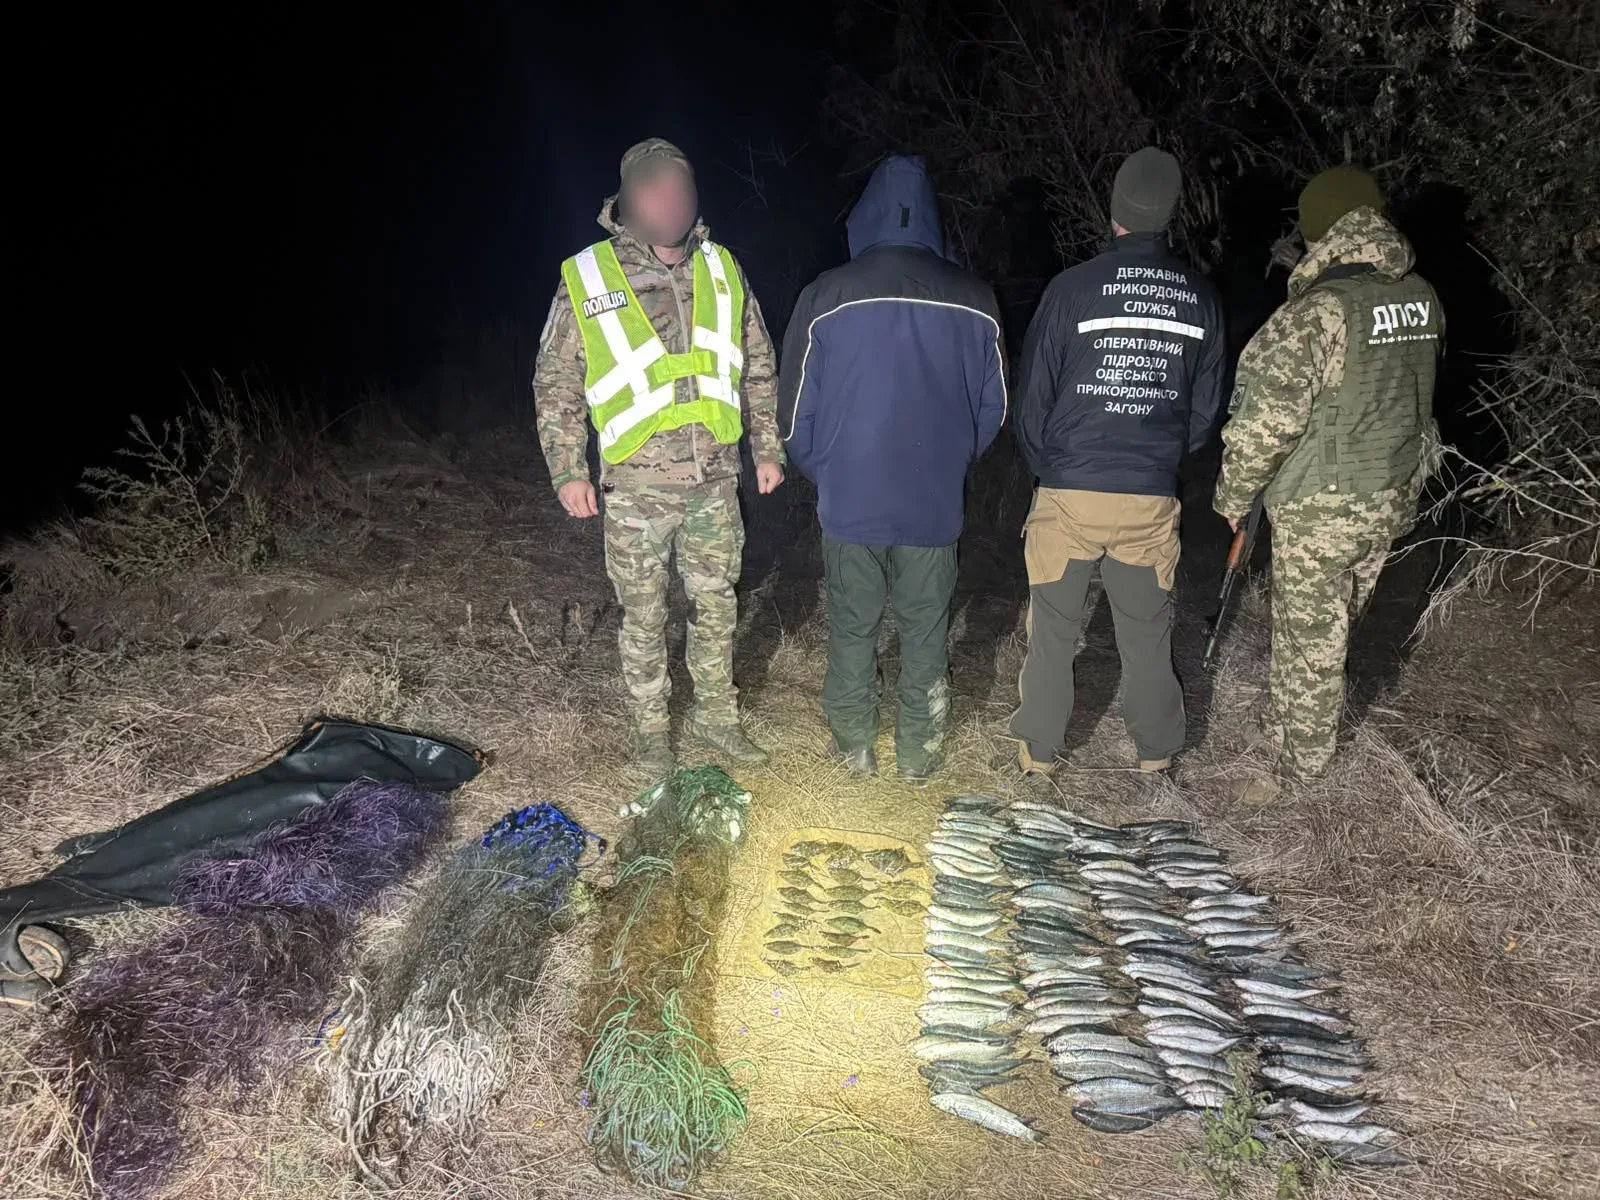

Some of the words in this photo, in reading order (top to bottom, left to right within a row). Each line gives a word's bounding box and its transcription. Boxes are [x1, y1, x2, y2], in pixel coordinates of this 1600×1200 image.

[1116, 267, 1188, 285] ДЕРЖАВНА
[1102, 284, 1198, 304] ПРИКОРДОННА
[583, 291, 627, 317] ПОЛІЦІЯ
[1123, 300, 1177, 317] СЛУЖБА
[1372, 301, 1430, 336] ДПСУ
[1093, 337, 1184, 356] ОПЕРАТИВНИЙ
[1104, 401, 1154, 415] ЗАГОНУ
